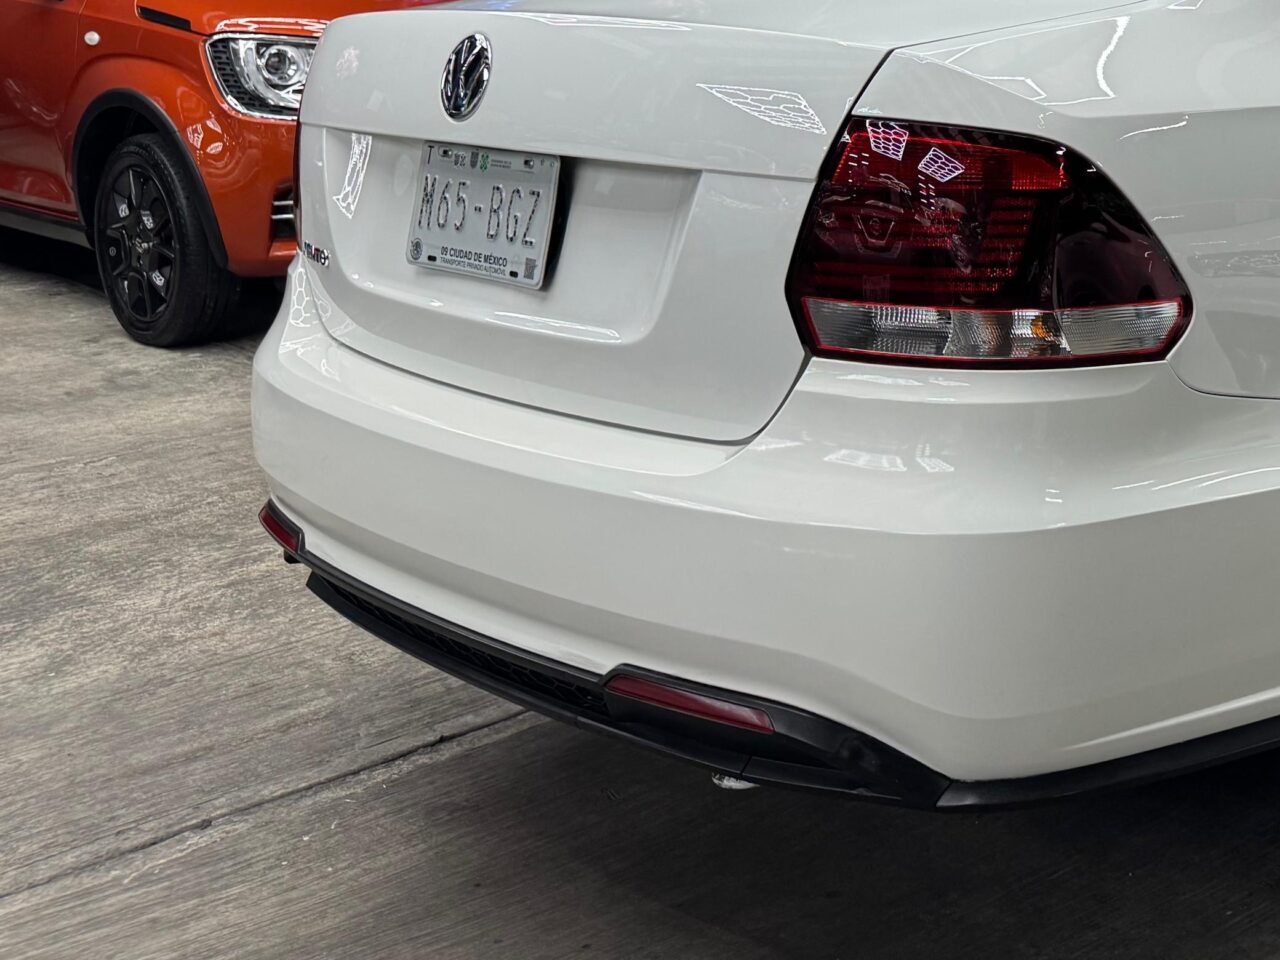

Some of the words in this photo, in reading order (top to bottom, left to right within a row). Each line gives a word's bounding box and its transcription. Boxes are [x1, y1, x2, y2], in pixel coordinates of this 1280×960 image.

[427, 145, 435, 164] T
[418, 174, 542, 247] M65-BGZ
[440, 246, 448, 256] 09
[449, 248, 473, 261] CIUDAD
[474, 251, 483, 262] DE
[484, 253, 508, 267] MÉXICO
